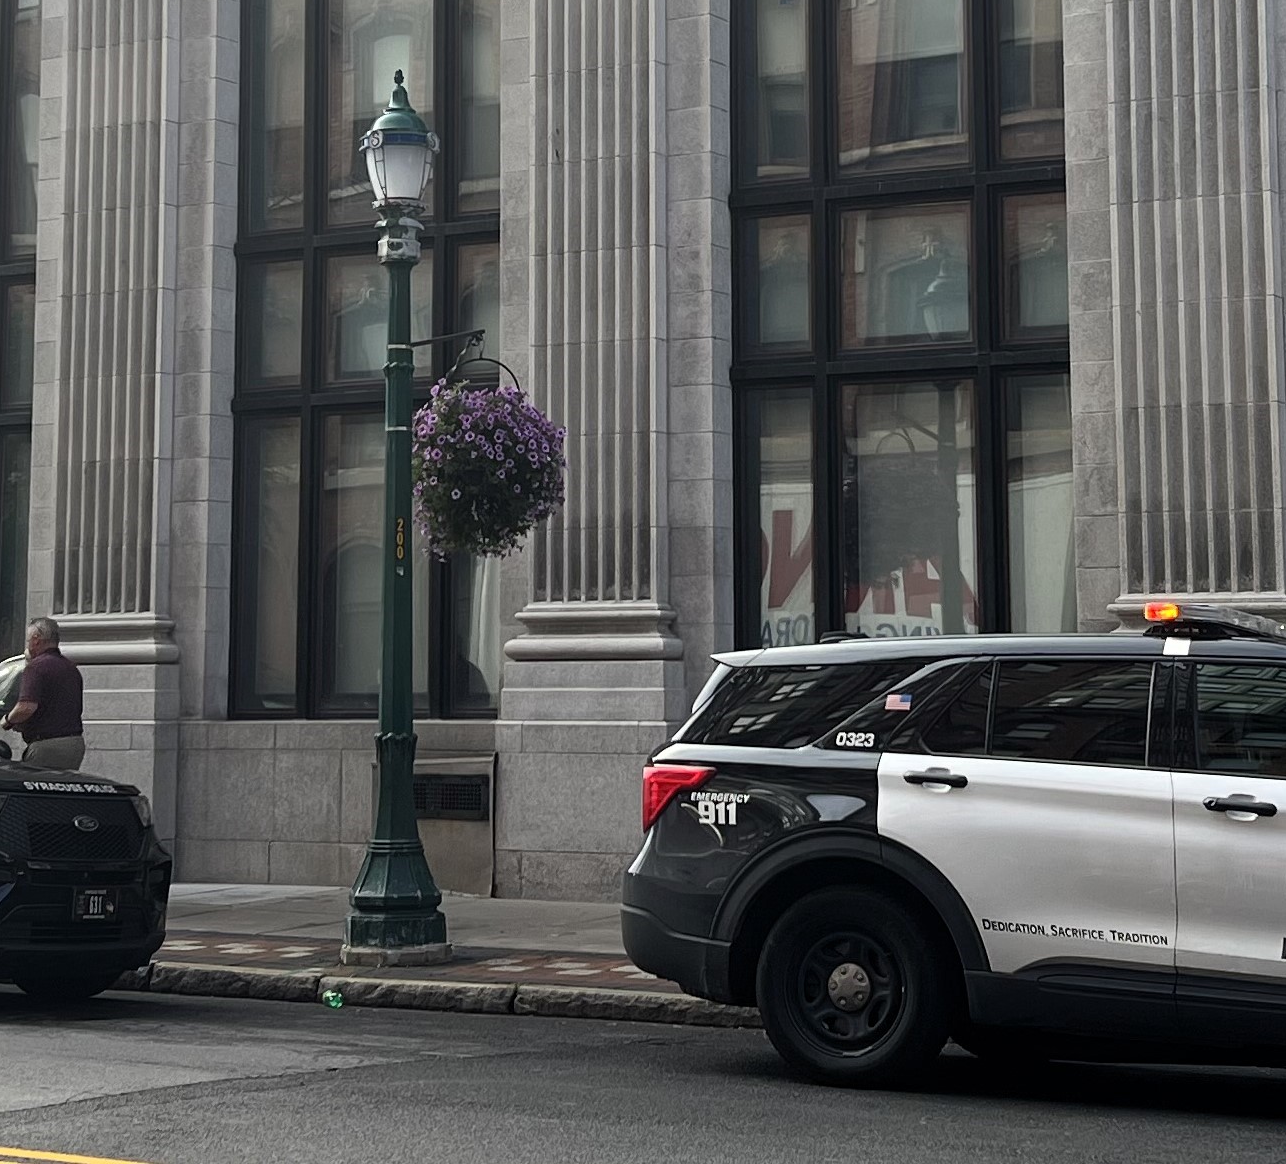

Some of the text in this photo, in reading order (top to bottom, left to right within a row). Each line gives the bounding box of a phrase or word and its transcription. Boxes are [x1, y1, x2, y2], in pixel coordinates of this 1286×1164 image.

[396, 517, 404, 559] 200
[835, 731, 875, 747] 0323
[23, 781, 85, 793] SYRACUSE
[691, 791, 751, 804] EMERGENCY
[698, 801, 737, 825] 911
